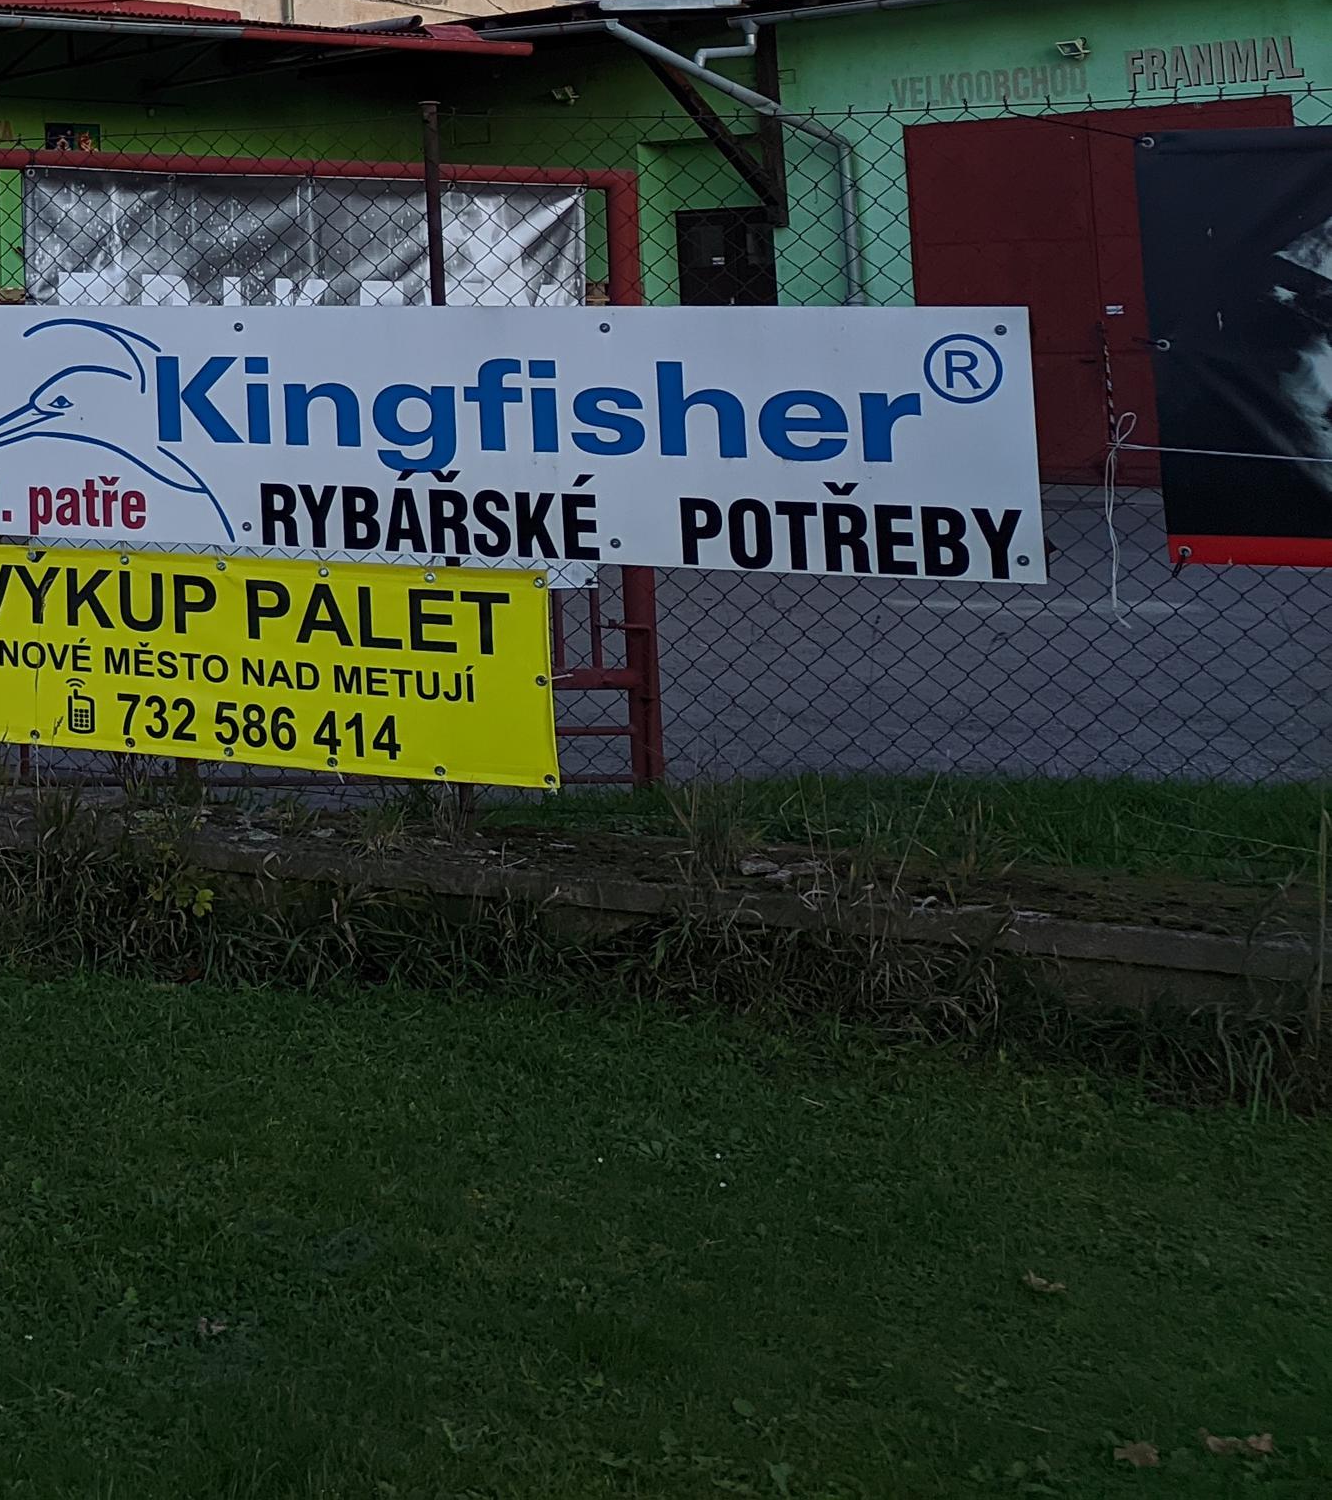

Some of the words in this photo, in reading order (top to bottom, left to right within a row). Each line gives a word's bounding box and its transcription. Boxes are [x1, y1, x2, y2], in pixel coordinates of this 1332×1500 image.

[890, 63, 1089, 110] VELKOOBCHOD
[1124, 35, 1305, 93] FRANIMAL
[155, 355, 923, 474] Kingfisher
[28, 476, 148, 536] patře
[260, 468, 602, 562] RYBÁŘSKÉ
[679, 481, 1023, 580] POTŘEBY
[245, 577, 511, 656] PALET
[104, 642, 230, 685] MĚSTO
[242, 658, 321, 692] NAD
[333, 664, 476, 704] METUJÍ
[116, 692, 198, 743] 732
[214, 700, 298, 753] 586
[313, 710, 403, 761] 414
